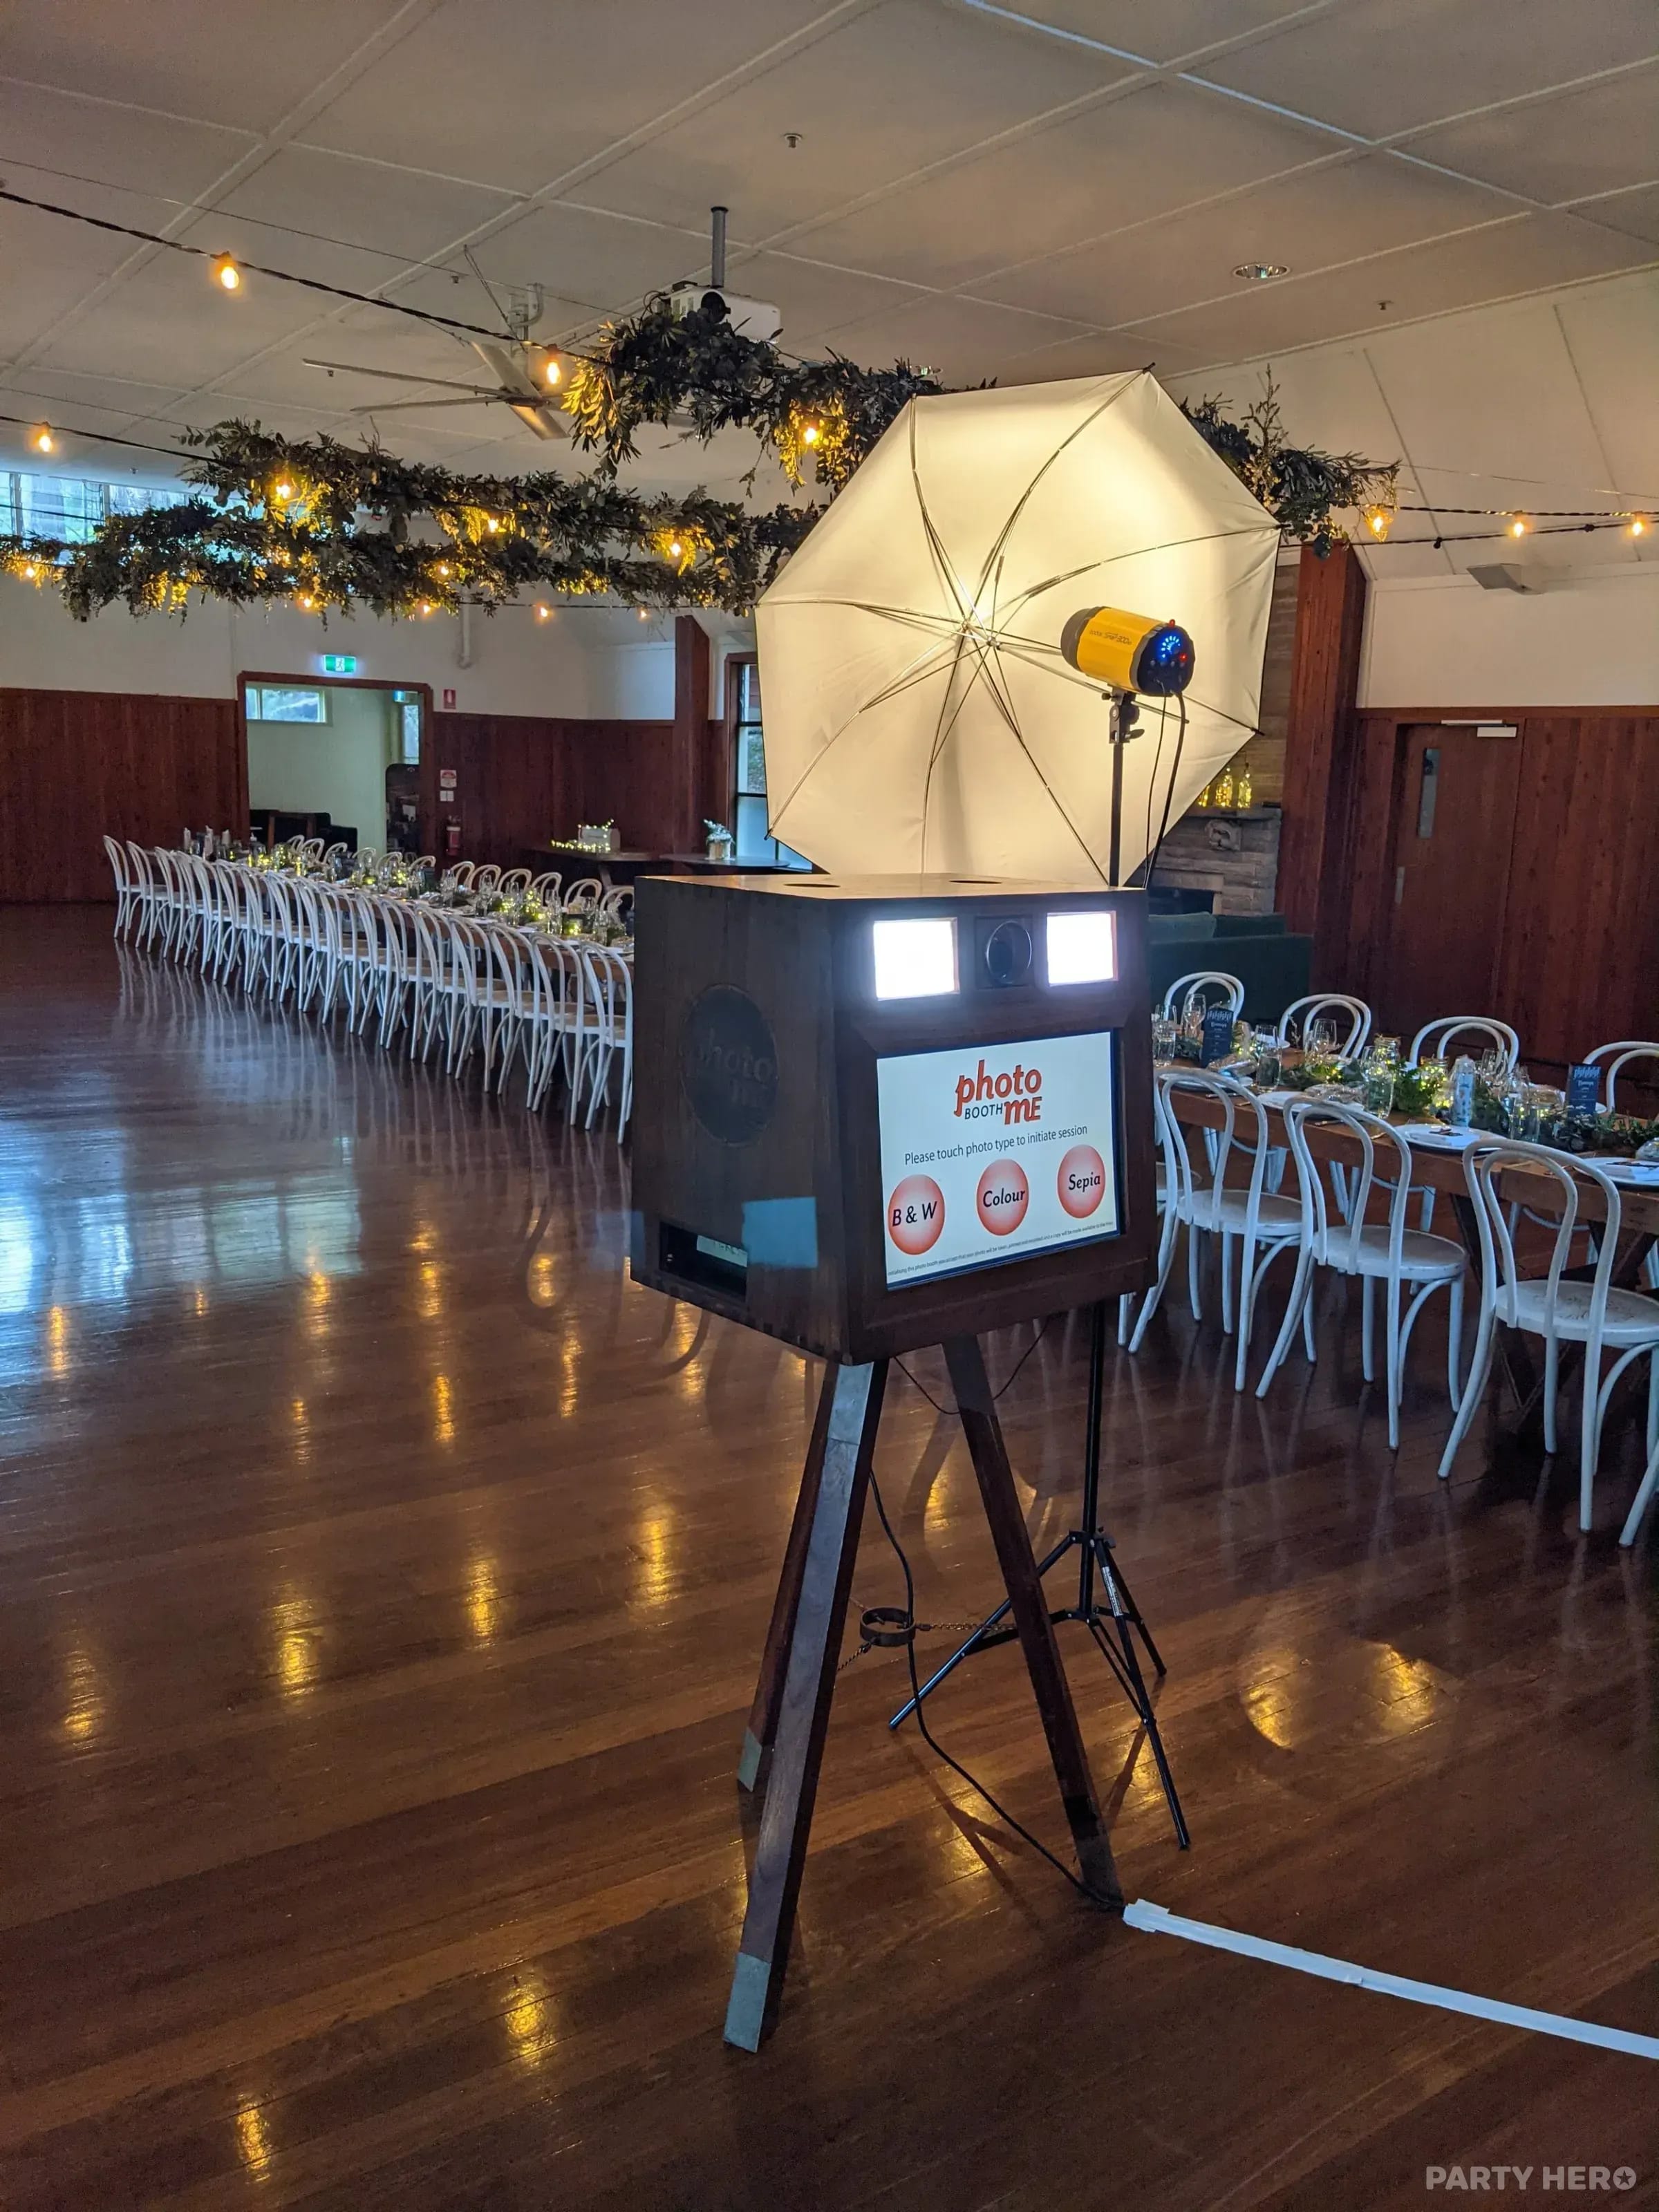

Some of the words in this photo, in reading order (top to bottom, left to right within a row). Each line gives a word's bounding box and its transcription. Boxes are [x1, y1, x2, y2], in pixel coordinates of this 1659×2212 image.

[954, 1059, 1042, 1117] photo
[964, 1103, 1003, 1120] BOOTH
[905, 1152, 935, 1165] Please
[937, 1144, 964, 1160] touch
[966, 1141, 993, 1158] photo
[995, 1137, 1015, 1152] type
[1017, 1136, 1026, 1146] to
[1027, 1130, 1056, 1144] initiate
[1058, 1125, 1088, 1138] session
[1068, 1171, 1101, 1192] Sepia
[982, 1188, 1026, 1208] Colour
[892, 1208, 902, 1227] B
[906, 1206, 918, 1224] &
[921, 1201, 938, 1219] W
